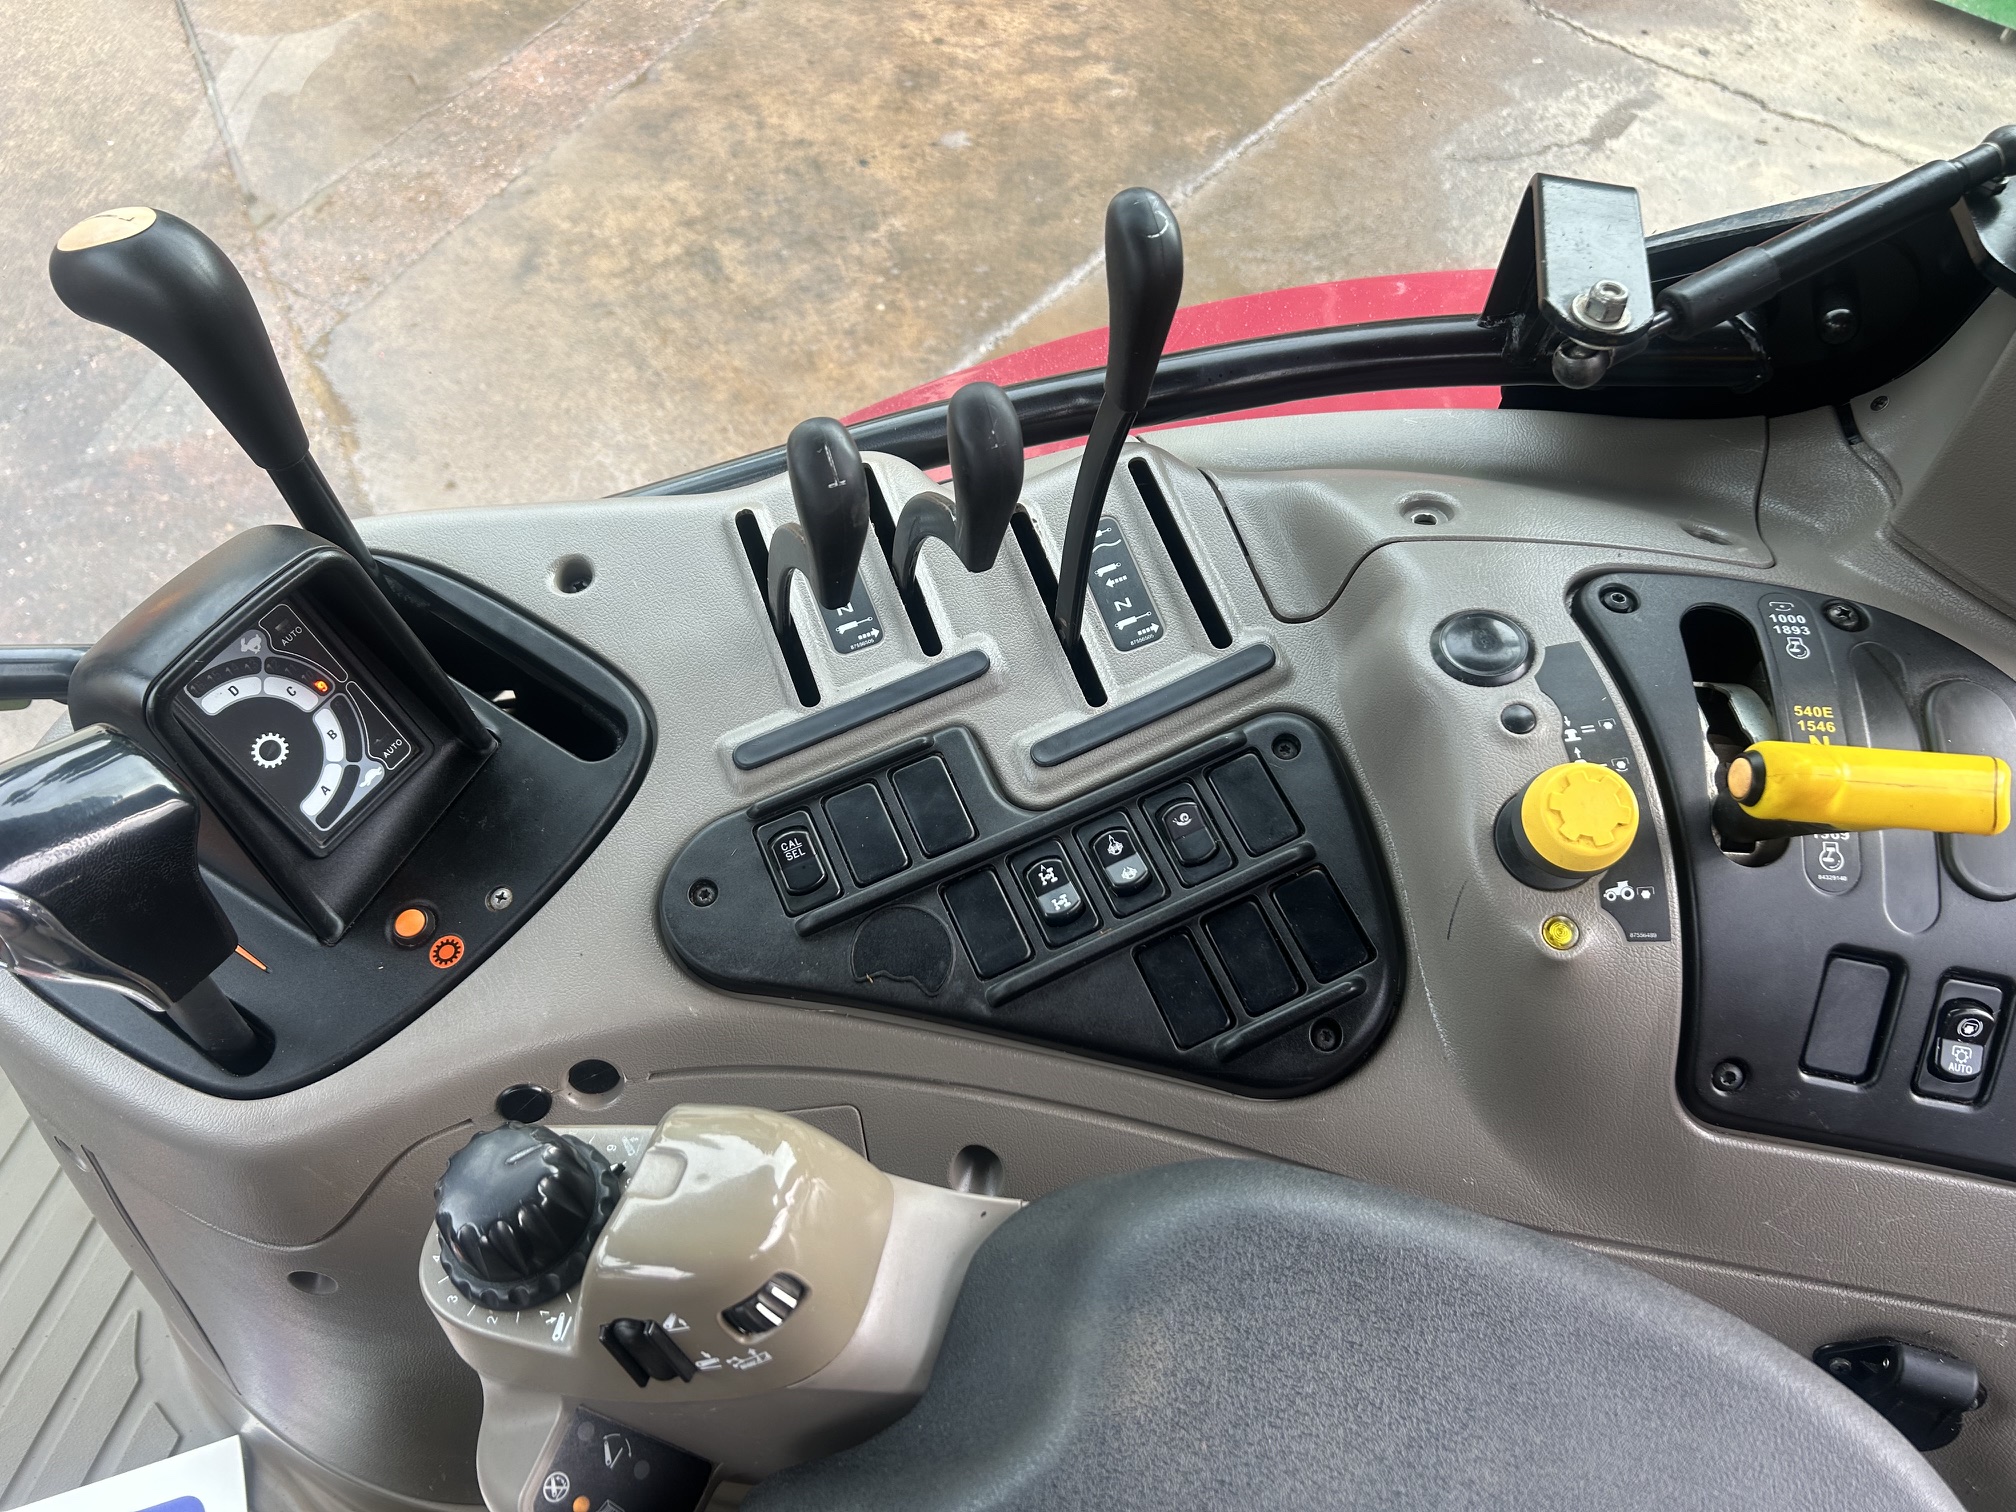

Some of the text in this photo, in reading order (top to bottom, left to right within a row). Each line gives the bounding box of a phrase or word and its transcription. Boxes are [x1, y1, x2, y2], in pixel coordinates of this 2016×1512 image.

[1114, 597, 1132, 612] N
[1769, 613, 1806, 624] 1000
[281, 626, 303, 647] AUTO
[1773, 625, 1811, 636] 1893
[228, 685, 239, 697] D
[286, 686, 297, 697] C
[316, 680, 328, 692] 9
[1793, 705, 1834, 718] 540E
[1797, 720, 1836, 733] 1546
[327, 729, 338, 740] B
[383, 738, 403, 758] AUTO
[321, 785, 332, 796] A
[780, 838, 802, 851] CAL
[785, 848, 806, 861] SEL
[1948, 1062, 1973, 1074] AUTO
[606, 1144, 617, 1152] 9
[446, 1294, 458, 1303] 3
[486, 1315, 498, 1325] 2
